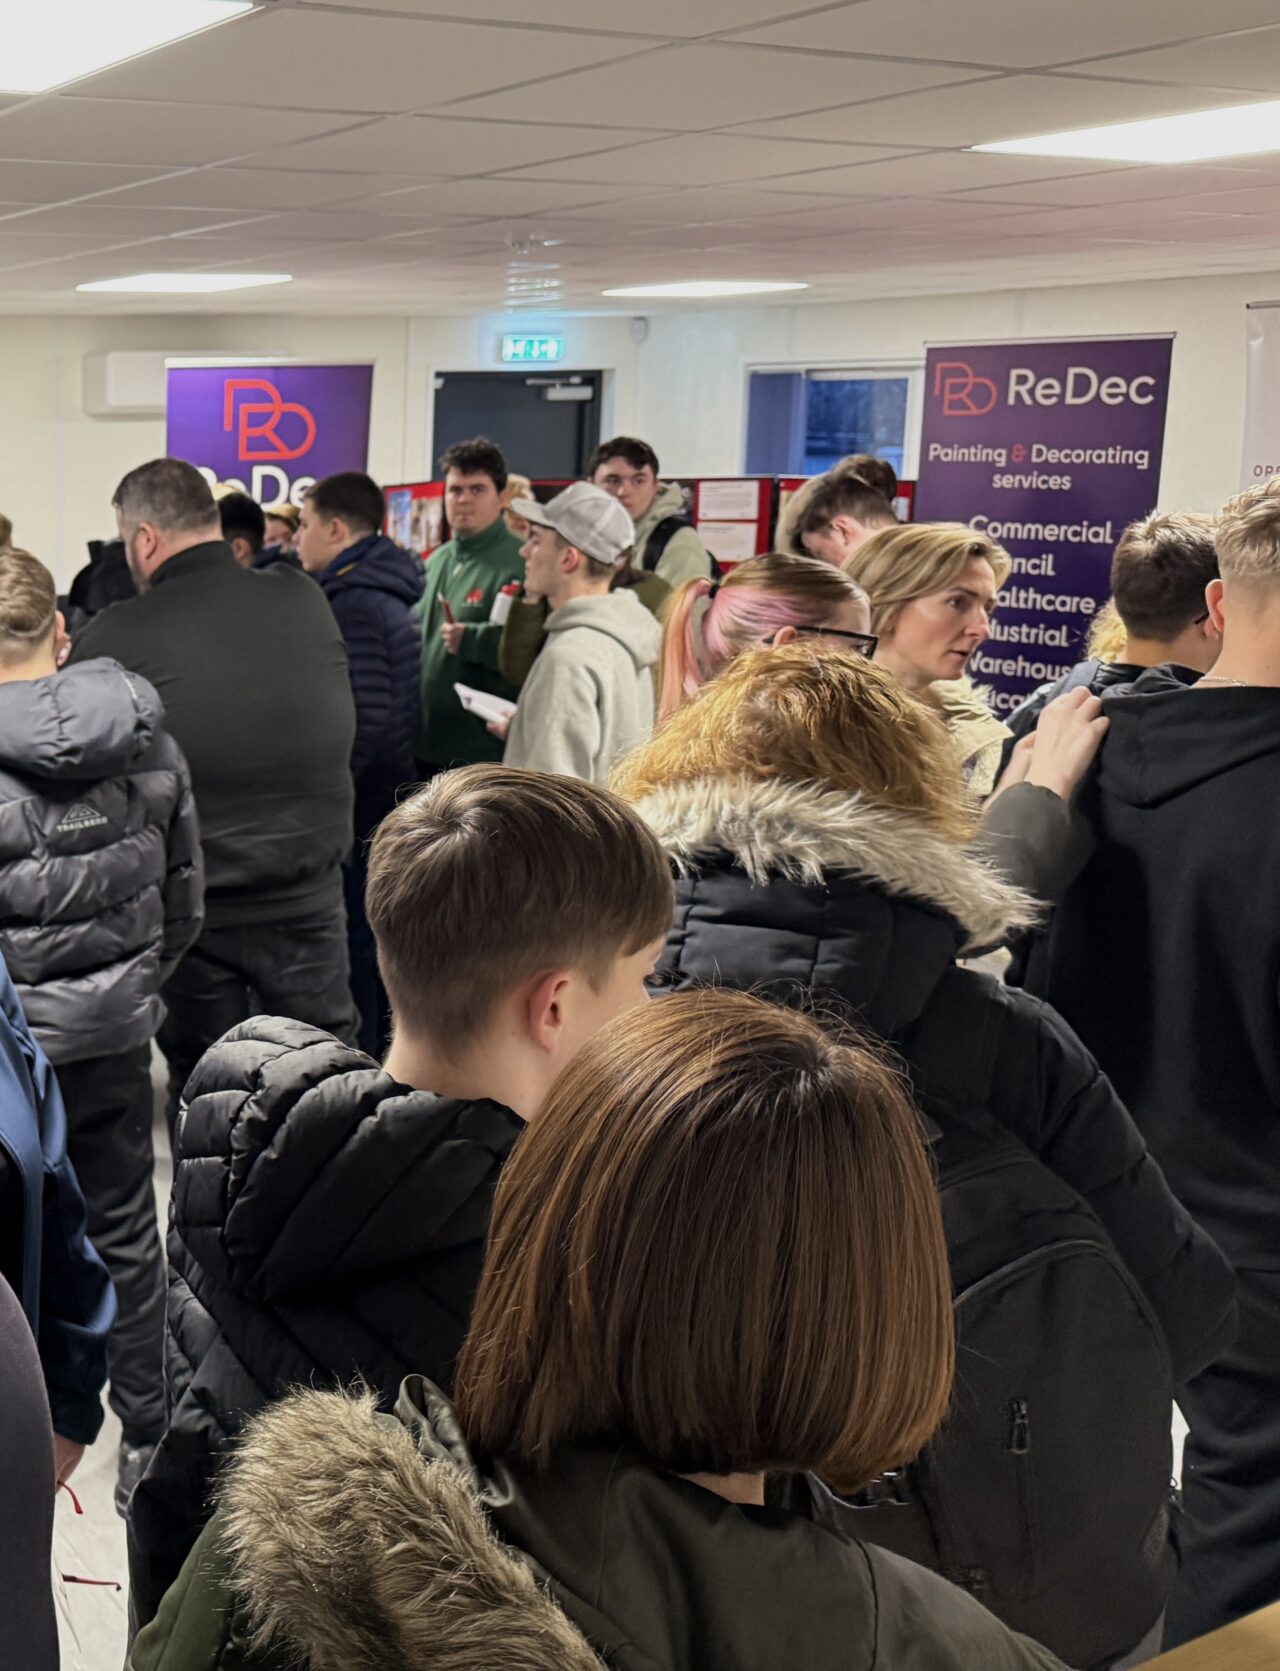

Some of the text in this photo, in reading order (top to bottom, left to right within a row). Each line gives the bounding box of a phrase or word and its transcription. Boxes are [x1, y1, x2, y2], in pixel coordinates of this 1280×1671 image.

[1007, 367, 1156, 405] ReDec
[928, 443, 1149, 469] Painting & Decorating
[992, 471, 1071, 490] services
[970, 515, 1114, 544] Commercial
[996, 585, 1097, 614] althcare
